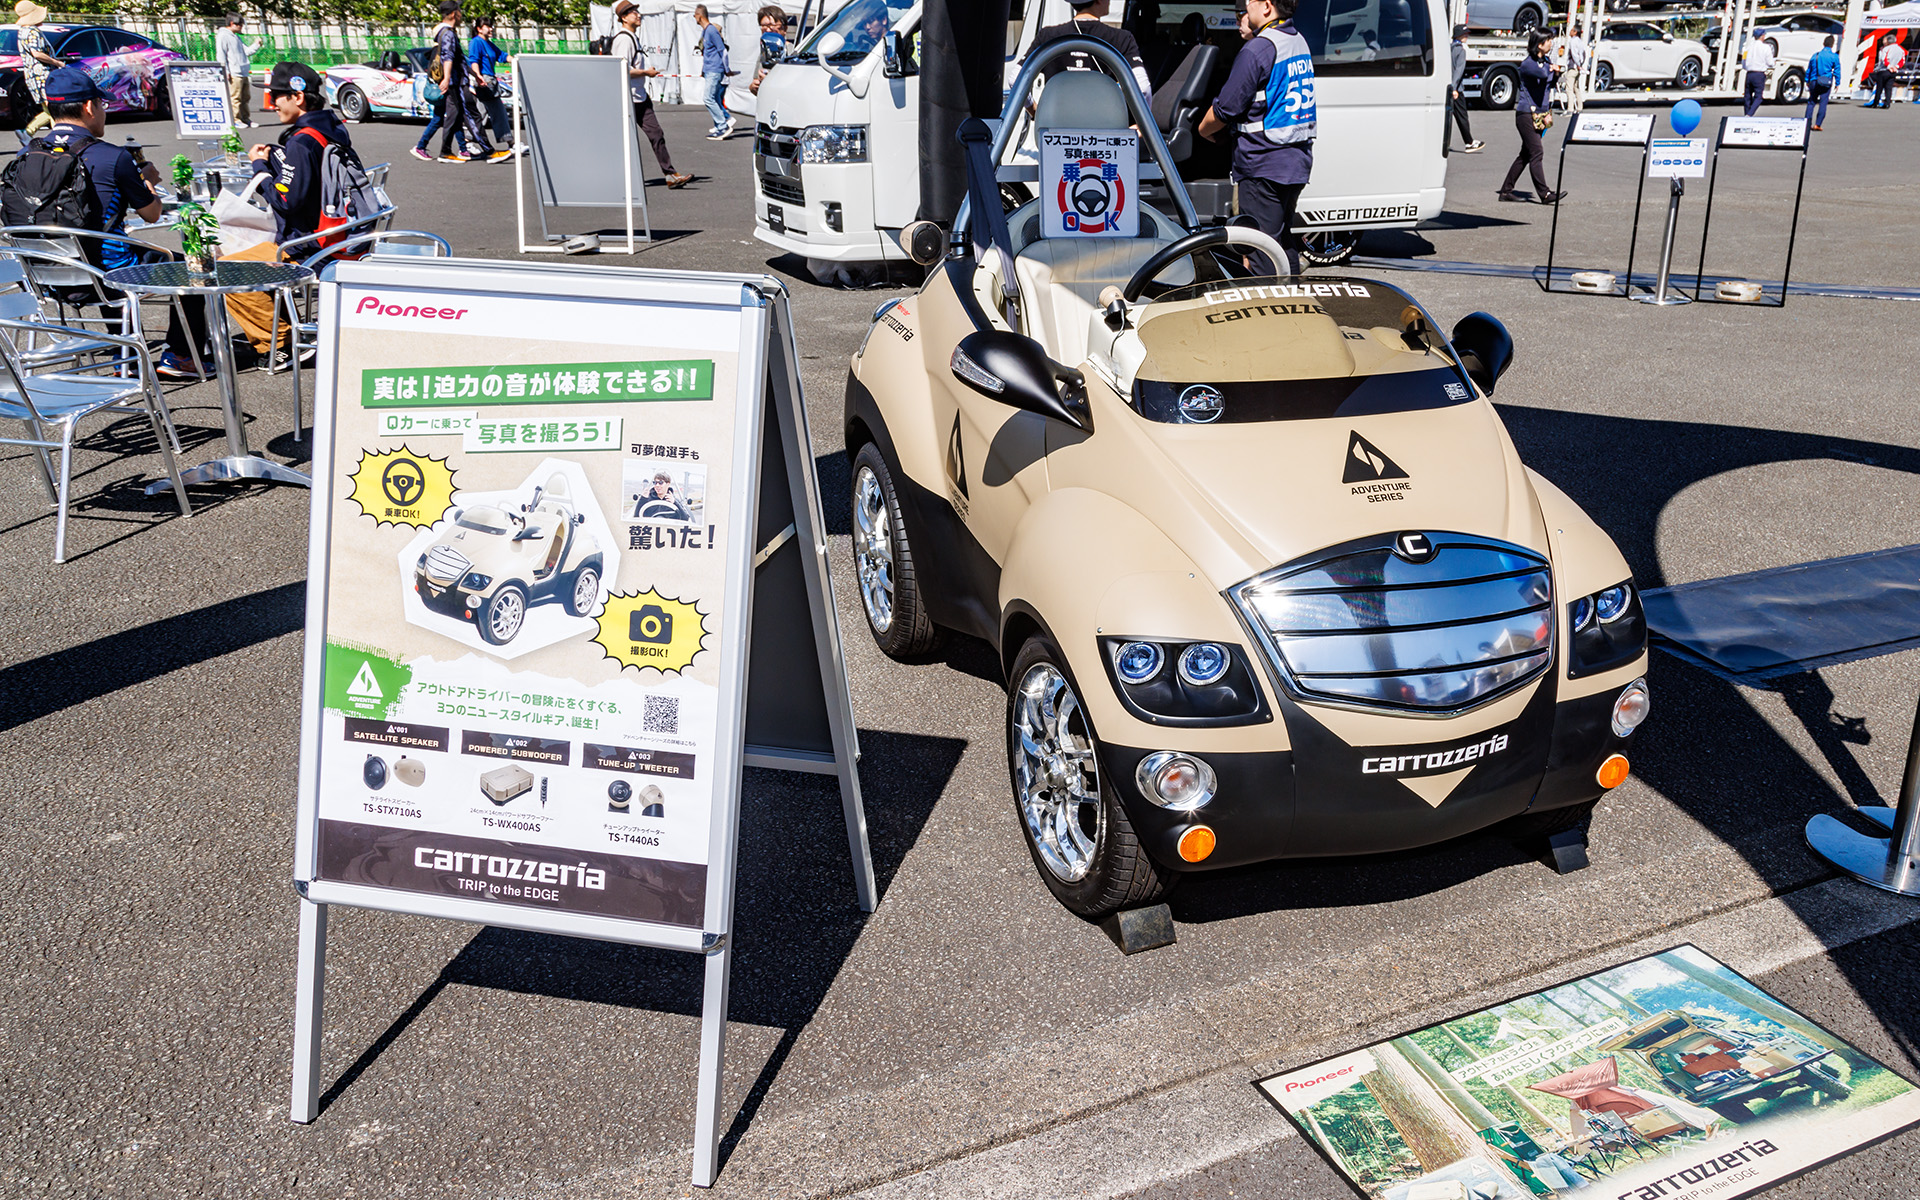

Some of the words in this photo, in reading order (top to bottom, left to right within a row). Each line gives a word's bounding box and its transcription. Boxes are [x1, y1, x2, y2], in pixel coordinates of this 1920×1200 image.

[1288, 57, 1315, 79] MEDIA
[1044, 135, 1135, 147] マスコットカーに乗って
[1327, 203, 1418, 221] carrozzeria
[1203, 282, 1371, 305] carrozzeria
[356, 296, 468, 320] Pioneer
[373, 367, 697, 401] 実は！迫力の音が体験できる！！
[387, 415, 472, 431] Qカーに乗って
[478, 420, 611, 445] 写真を撮ろう！
[631, 443, 699, 460] 可夢偉選手も
[1351, 482, 1412, 496] ADVENTURE
[1367, 492, 1404, 503] SERIES
[629, 524, 716, 550] 驚いた！
[353, 731, 399, 743] SATELLITE
[401, 736, 439, 748] SPEAKER
[468, 744, 508, 756] POWERED
[511, 750, 562, 762] SUBWOOFER
[1362, 734, 1509, 774] carrozzeria
[597, 758, 636, 770] TUNE-UP
[639, 762, 680, 774] TWEETER
[363, 802, 422, 819] TS-STX710AS
[482, 817, 541, 833] TS-WX400AS
[608, 832, 660, 847] TS-T440AS
[414, 846, 606, 890] carrozzeria
[458, 878, 487, 892] TRIP
[489, 884, 501, 894] to
[503, 885, 521, 897] the
[524, 887, 560, 901] EDGE
[1285, 1065, 1354, 1093] Pioneer
[1701, 1185, 1713, 1195] to
[1712, 1180, 1730, 1192] the
[1728, 1167, 1760, 1184] EDGE
